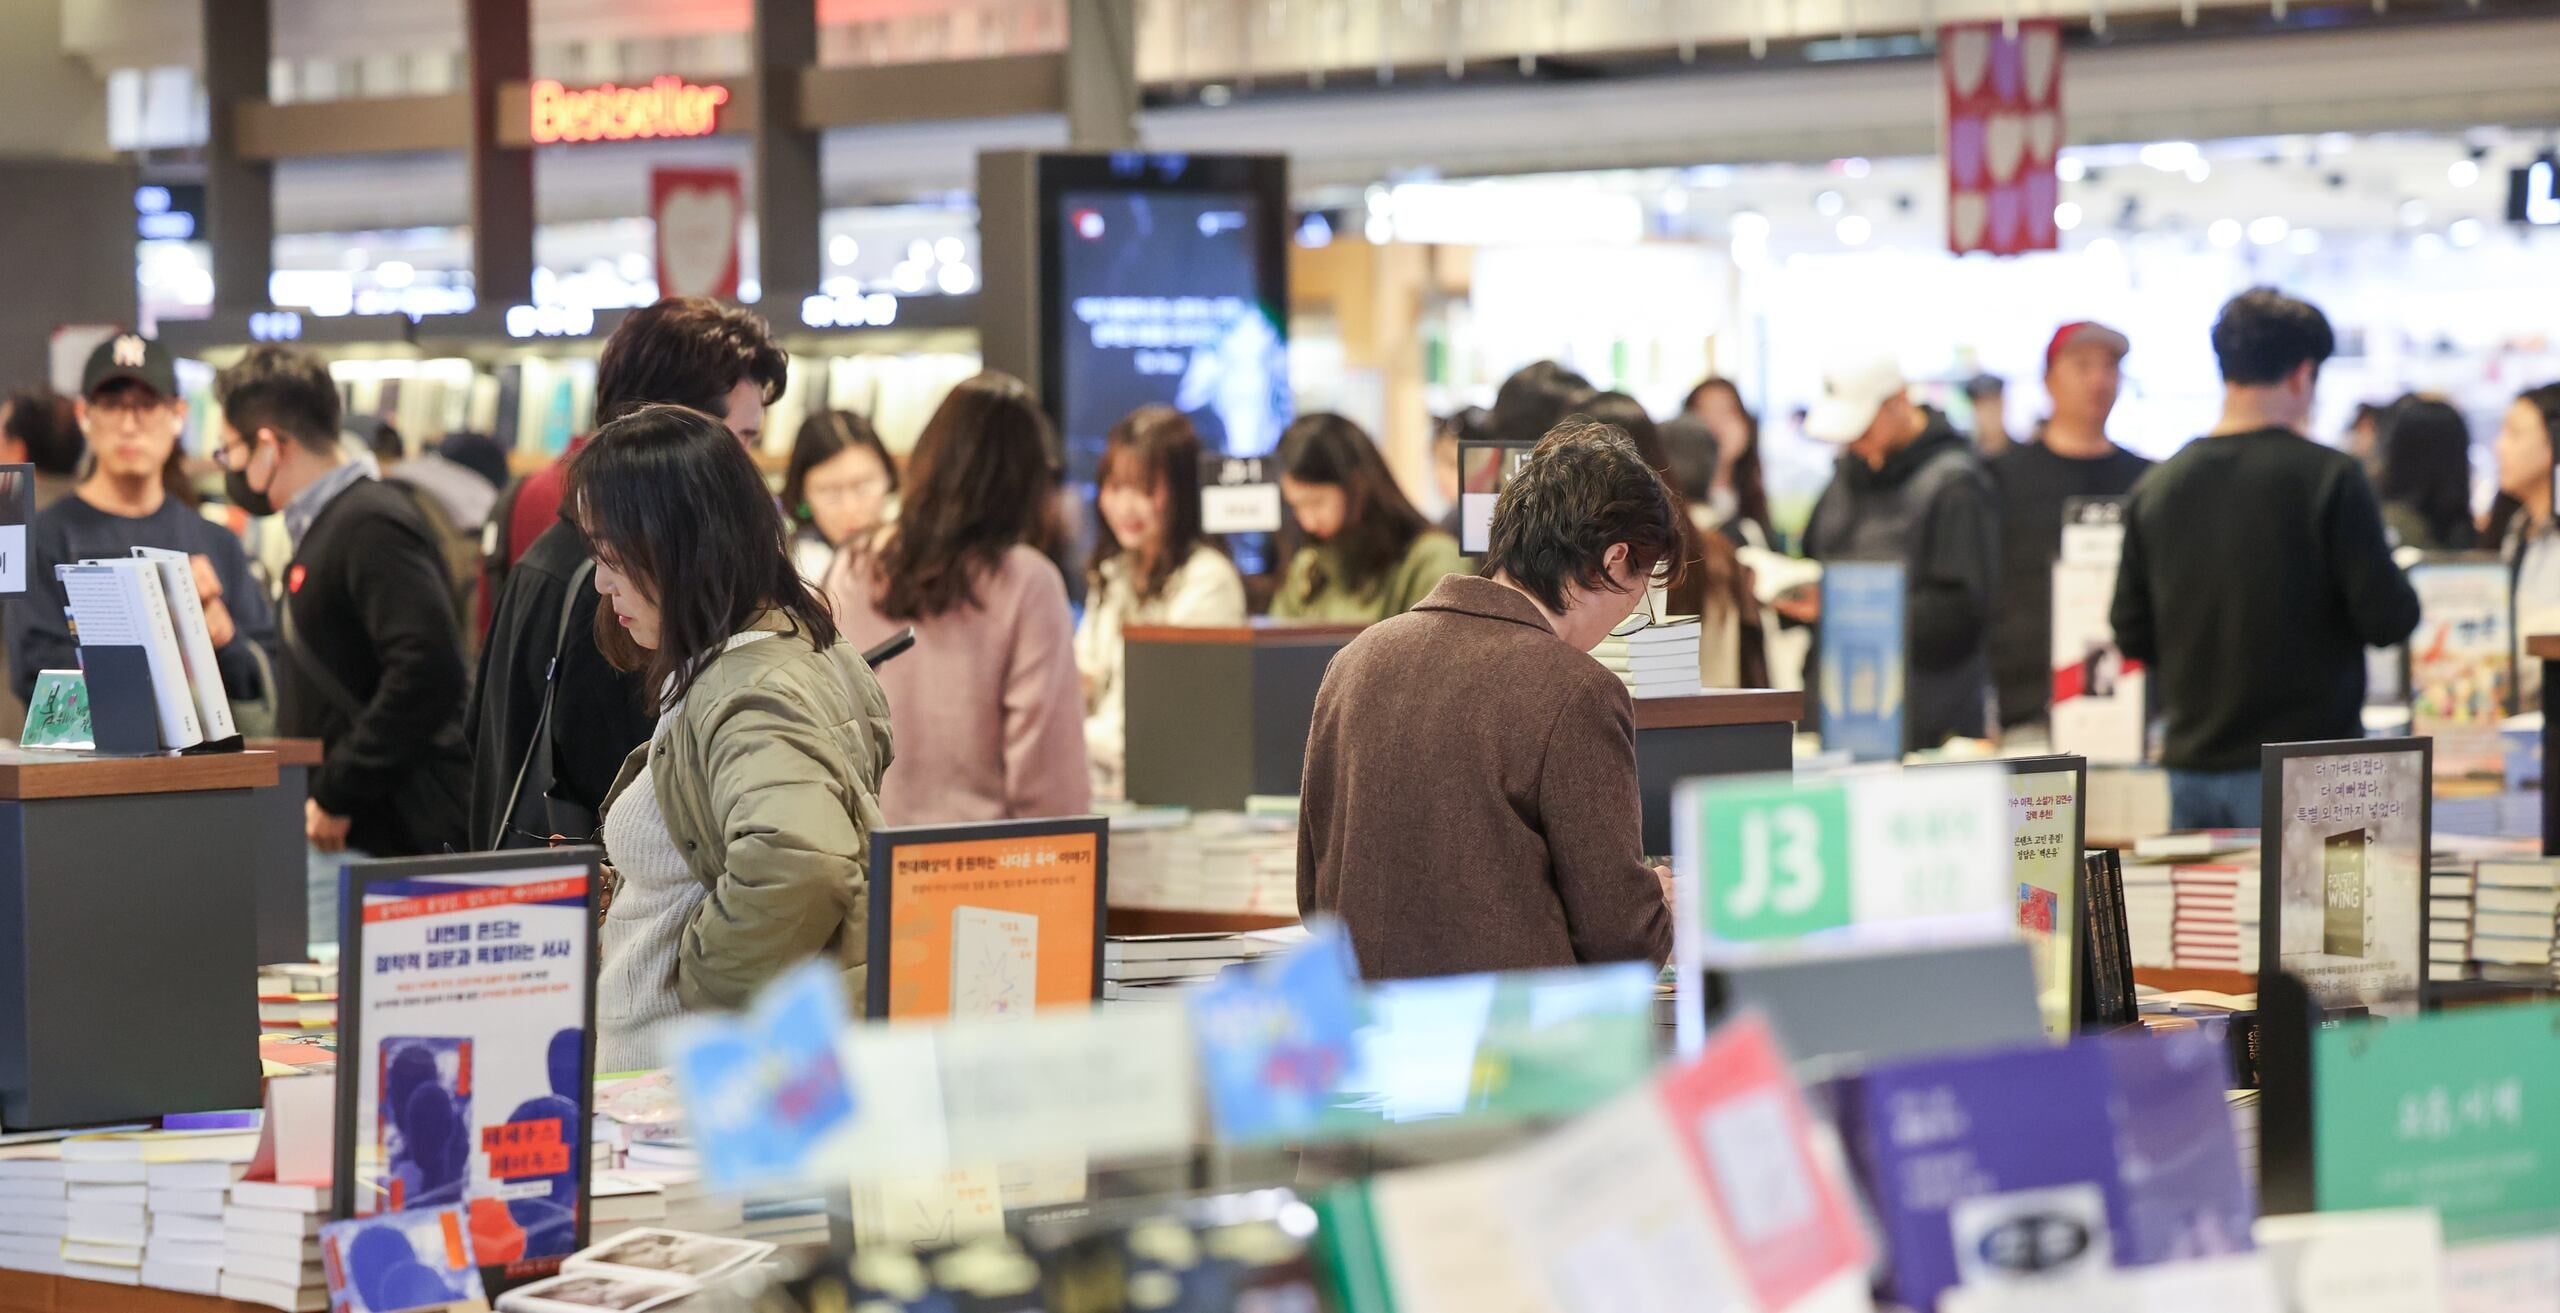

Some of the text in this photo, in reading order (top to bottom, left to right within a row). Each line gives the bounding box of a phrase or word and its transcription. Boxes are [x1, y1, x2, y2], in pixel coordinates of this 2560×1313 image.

[531, 75, 728, 143] Bestseller
[2315, 759, 2388, 777] 더 가벼워졌다,
[2320, 780, 2381, 798] 더 예뻐졌다,
[2036, 796, 2053, 806] 소설가
[2056, 795, 2073, 805] 김연수
[2026, 810, 2053, 821] 강력 추천!
[2296, 801, 2404, 823] 특별 외전까지 넣었다!
[2034, 834, 2047, 845] 고민
[955, 855, 996, 872] 응원하는
[1722, 802, 1825, 921] J3
[2017, 849, 2036, 861] 정답은
[2328, 871, 2358, 888] FOURTH
[2328, 888, 2360, 909] WING
[540, 939, 571, 958] 서사
[2247, 1031, 2255, 1060] WING
